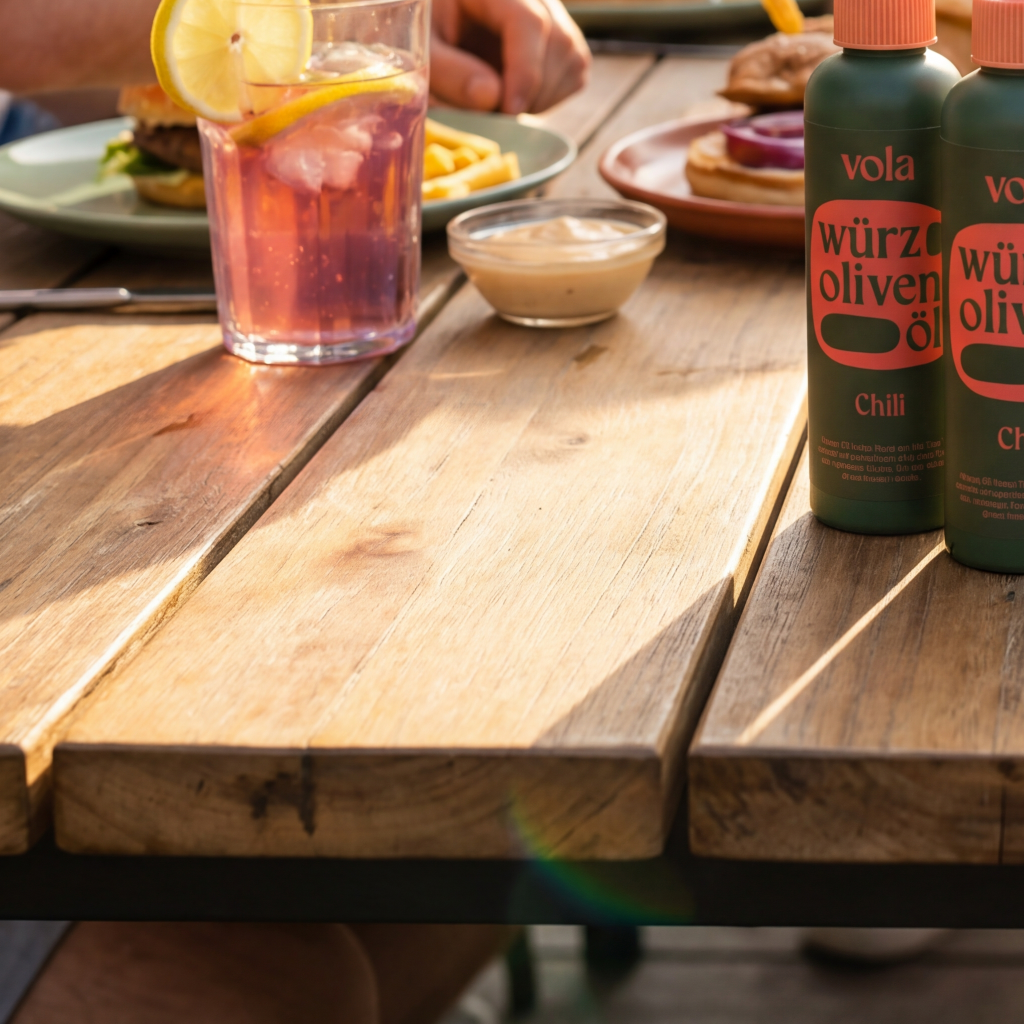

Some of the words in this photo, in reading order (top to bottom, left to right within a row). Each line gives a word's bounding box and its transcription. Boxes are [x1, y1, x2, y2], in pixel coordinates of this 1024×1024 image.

[841, 145, 915, 182] vola
[817, 216, 921, 259] würz
[819, 261, 941, 306] oliven
[906, 305, 942, 352] öl
[854, 392, 906, 417] Chili
